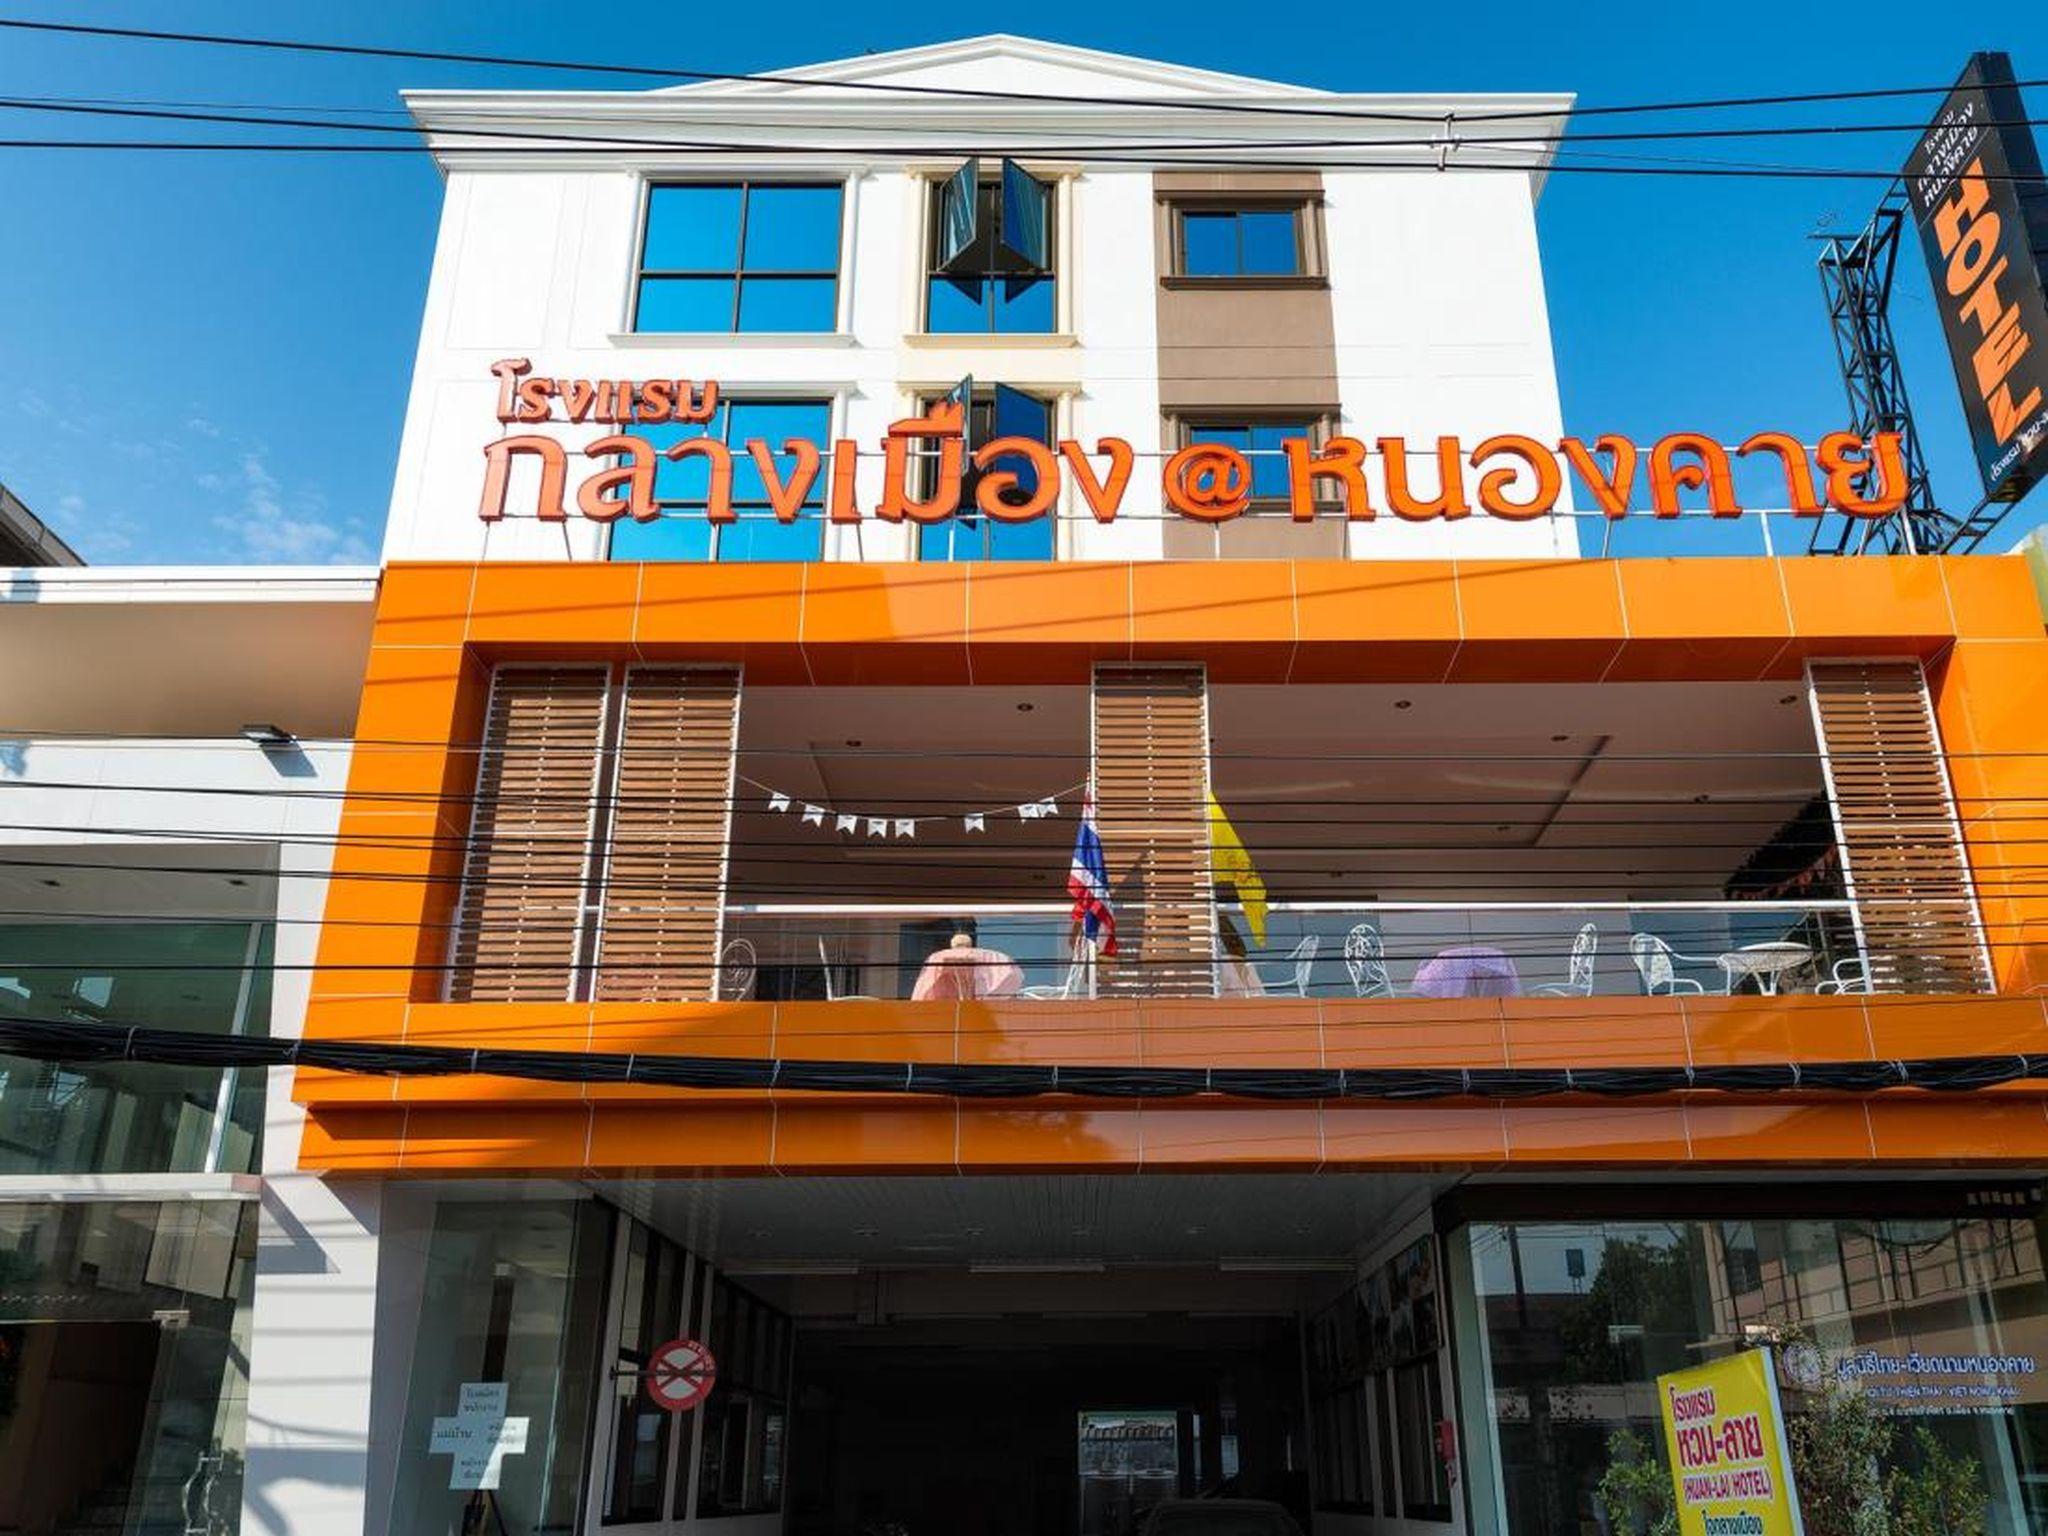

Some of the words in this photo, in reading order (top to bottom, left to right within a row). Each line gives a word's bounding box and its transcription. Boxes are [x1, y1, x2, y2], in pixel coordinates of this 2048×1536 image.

[1933, 156, 2042, 446] HOTEL
[490, 357, 720, 425] โรงแรม
[478, 400, 1135, 526] กลางเมือง
[1162, 441, 1253, 523] @
[1281, 430, 1911, 524] หนองคาย
[1669, 1386, 1716, 1422] โรงแรม
[1676, 1415, 1765, 1467] หวน-ลาย
[1731, 1469, 1774, 1500] HOTEL)
